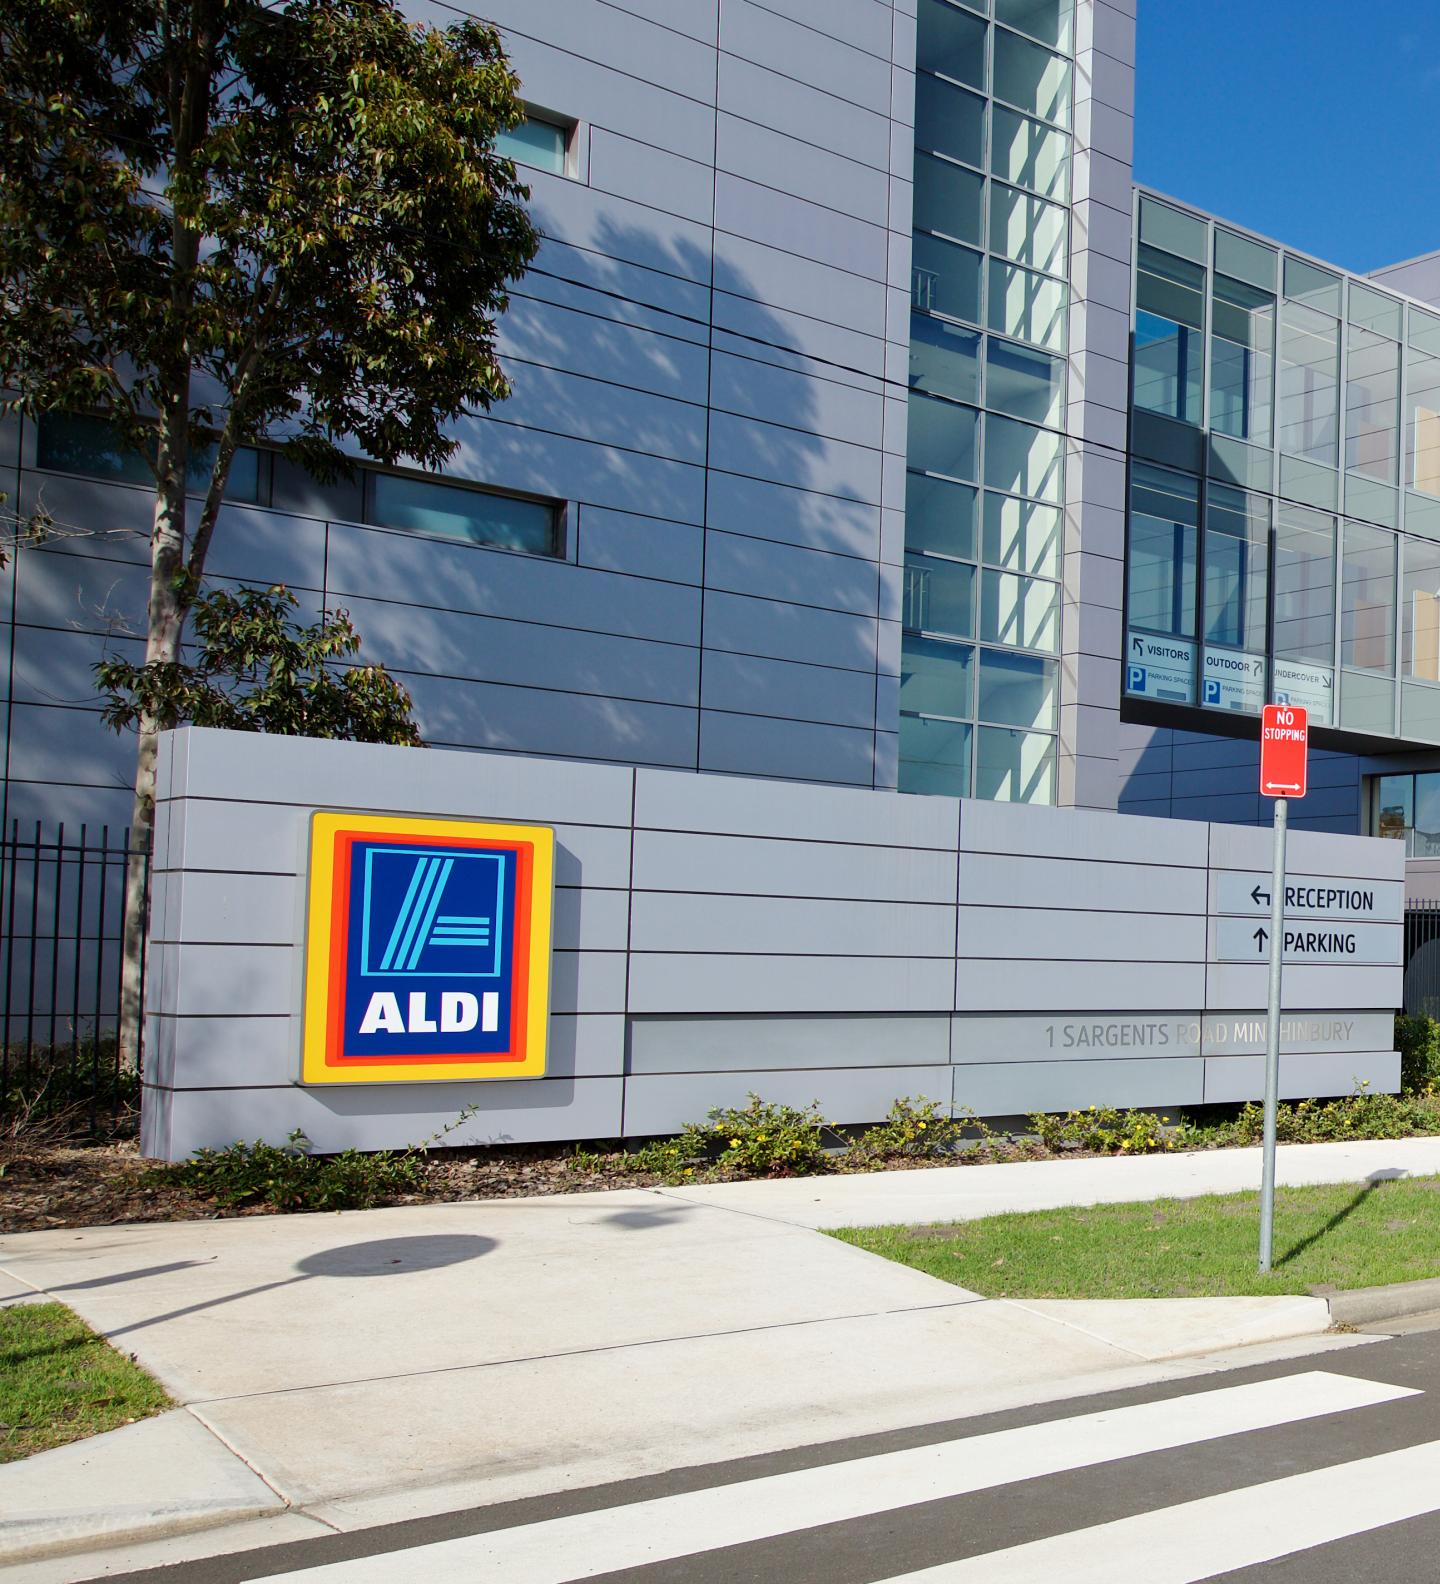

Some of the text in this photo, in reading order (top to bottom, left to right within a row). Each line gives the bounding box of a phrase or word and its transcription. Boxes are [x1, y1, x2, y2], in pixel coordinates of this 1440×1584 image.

[1147, 645, 1190, 661] VISITORS
[1206, 656, 1250, 672] OUTDOOR
[1130, 668, 1143, 690] P
[1206, 682, 1218, 702] P
[1276, 711, 1294, 725] NO
[1264, 728, 1305, 741] STOPPING
[1285, 887, 1373, 910] RECEPTION
[1284, 932, 1356, 953] PARKING
[358, 991, 499, 1034] ALDI
[1046, 1021, 1354, 1047] 1 SARGENTS ROAD MINHINBURY
